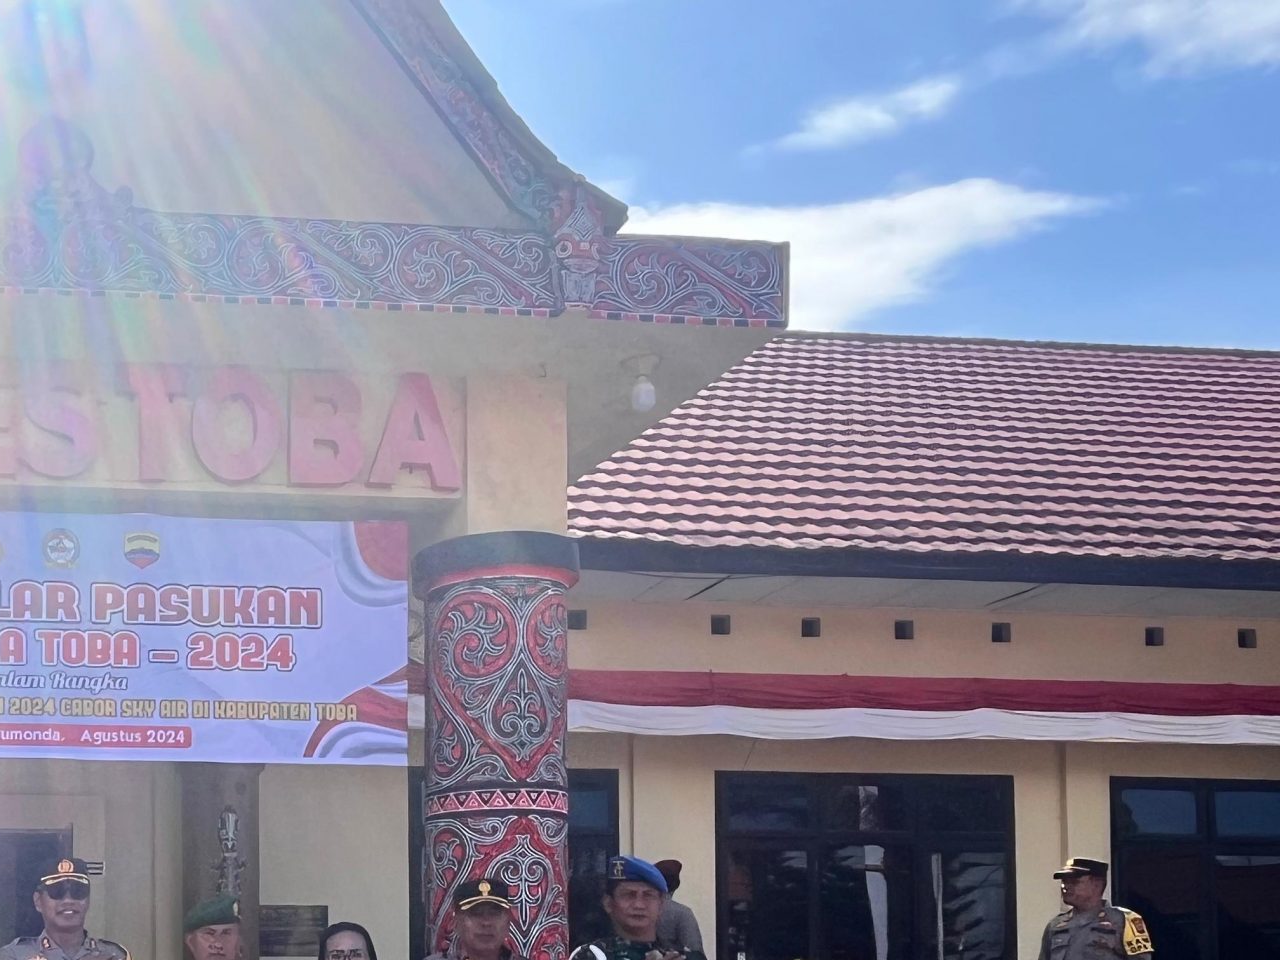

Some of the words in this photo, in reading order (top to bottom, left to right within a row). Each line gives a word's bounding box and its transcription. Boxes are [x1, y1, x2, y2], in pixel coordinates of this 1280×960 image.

[114, 362, 461, 491] TOBA
[91, 583, 322, 628] PASUKAN
[35, 629, 140, 668] TOBA
[186, 632, 296, 671] 2024
[50, 672, 128, 695] Rangka
[9, 696, 56, 716] 2024
[59, 697, 117, 717] CABOR
[120, 699, 156, 718] SKY
[159, 699, 190, 719] AIR
[192, 700, 210, 719] DI
[214, 701, 312, 721] KABUPATEN
[315, 703, 358, 721] TOBA
[80, 729, 142, 744] Agustus
[146, 730, 185, 743] 2024
